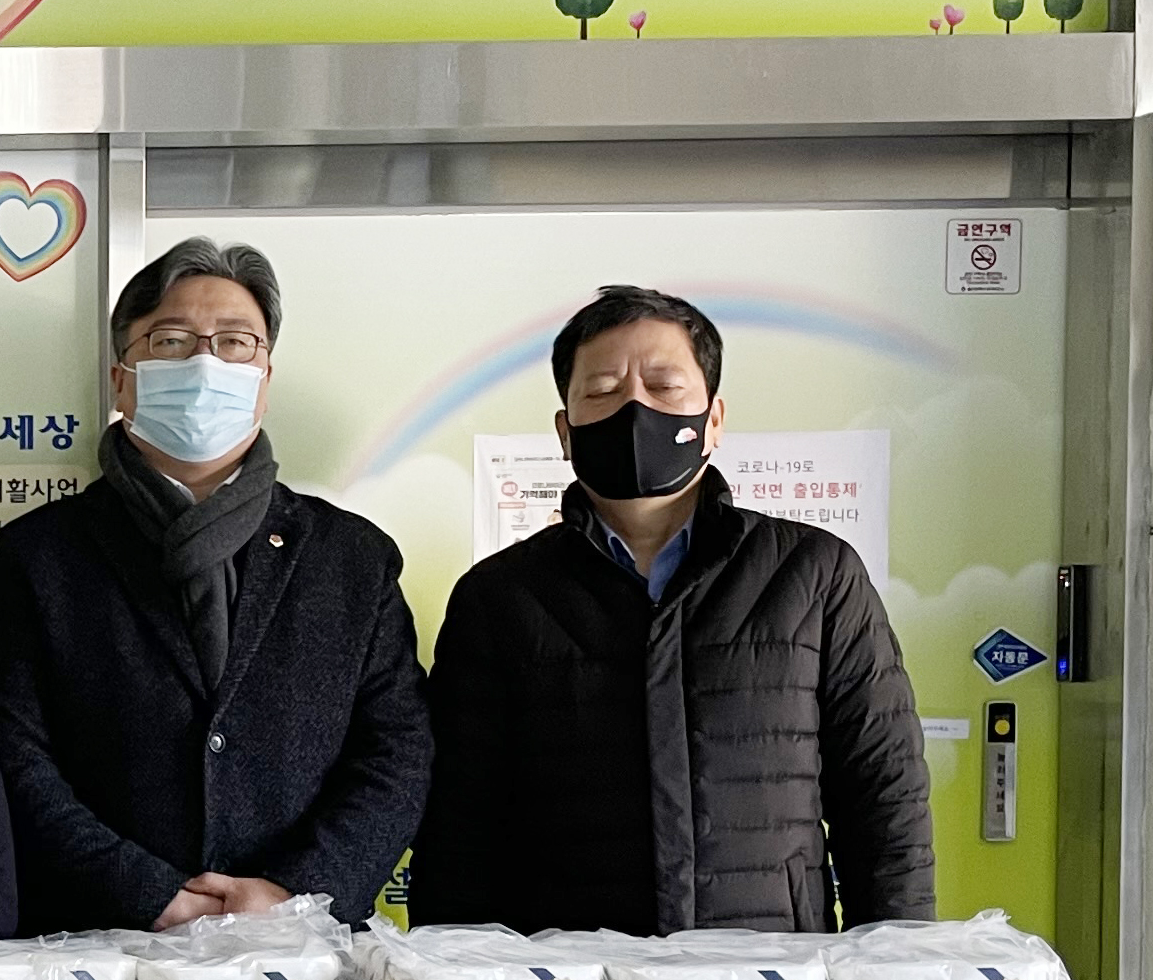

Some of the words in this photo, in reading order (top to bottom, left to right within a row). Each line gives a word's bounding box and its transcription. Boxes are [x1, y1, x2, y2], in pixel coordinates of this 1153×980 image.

[957, 223, 1011, 236] 금연구역
[752, 483, 783, 499] 전면
[992, 651, 1028, 665] 자동문
